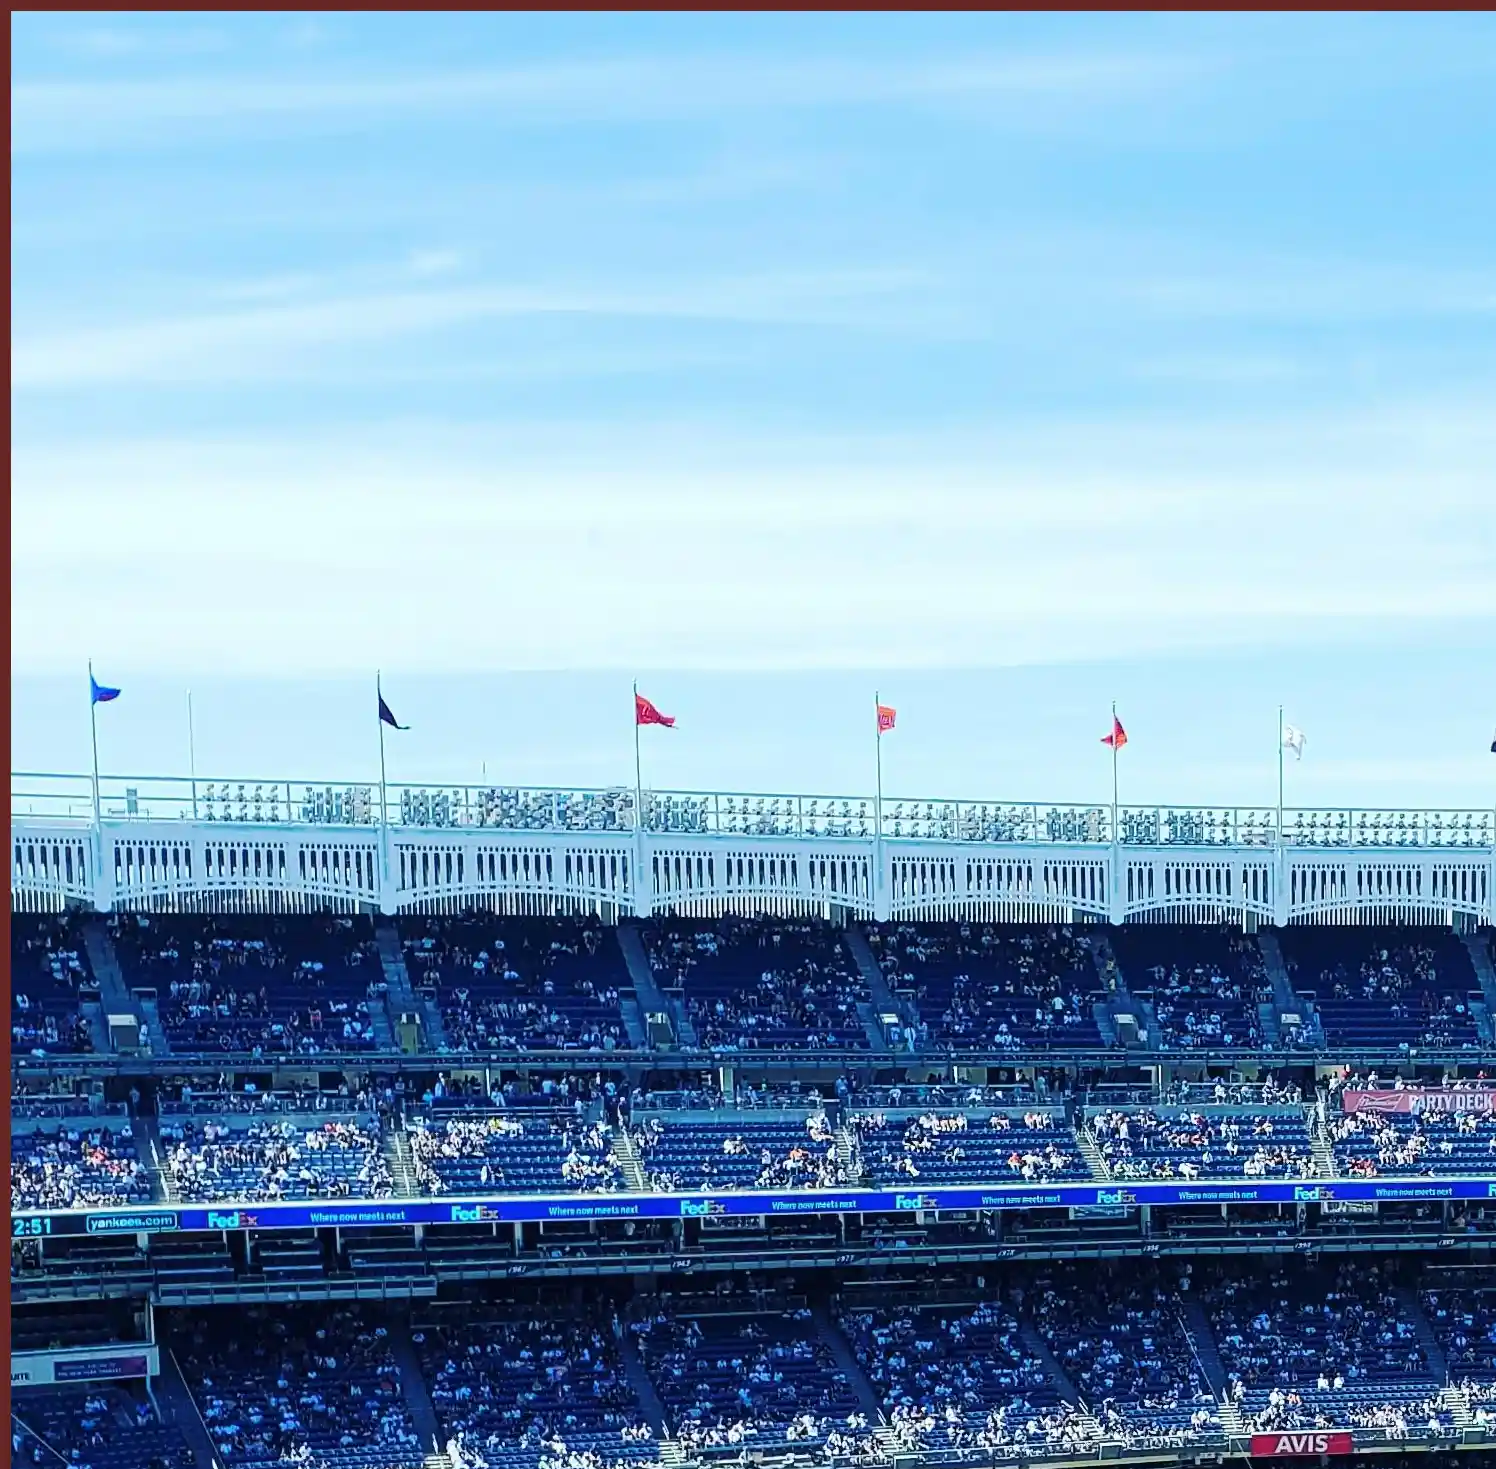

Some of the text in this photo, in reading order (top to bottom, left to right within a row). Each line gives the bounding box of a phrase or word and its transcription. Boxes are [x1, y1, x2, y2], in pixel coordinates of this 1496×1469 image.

[1408, 1094, 1455, 1110] PARTY
[1459, 1094, 1494, 1110] DECK
[895, 1194, 938, 1208] FedEx
[1096, 1190, 1137, 1204] FedEx
[1294, 1187, 1335, 1200] FedEx
[451, 1205, 499, 1221] FedEx
[548, 1206, 575, 1216] Where
[594, 1205, 619, 1215] meets
[620, 1205, 639, 1214] next
[680, 1200, 726, 1216] FedEx
[772, 1201, 796, 1210] Where
[840, 1200, 856, 1208] next
[90, 1215, 173, 1231] yankees.com
[208, 1212, 258, 1229] FedEx
[310, 1211, 338, 1222] Where
[359, 1211, 384, 1221] meets
[385, 1210, 405, 1220] next
[13, 1218, 51, 1236] 2:51
[1274, 1435, 1329, 1453] AVIS
